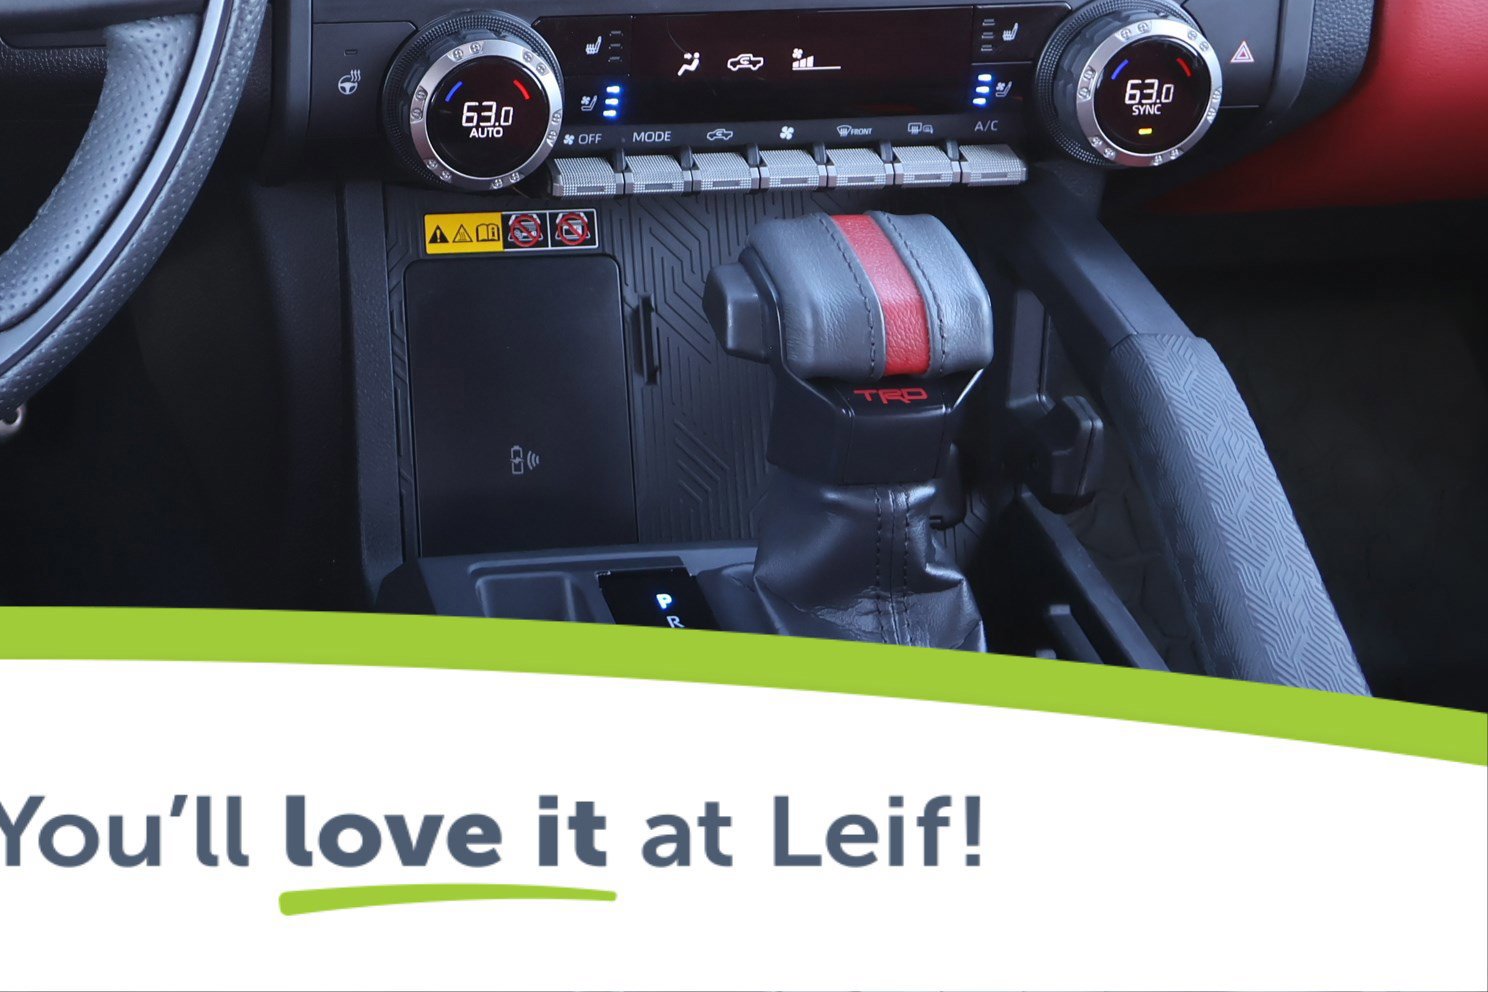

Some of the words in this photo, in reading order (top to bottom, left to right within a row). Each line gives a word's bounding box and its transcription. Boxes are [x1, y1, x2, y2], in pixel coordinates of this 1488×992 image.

[1124, 79, 1175, 105] 63.0
[462, 101, 514, 127] 63.0
[1132, 103, 1161, 115] SYNC
[469, 127, 503, 138] AUTO
[850, 126, 873, 136] FRONT
[974, 120, 998, 133] A/C
[578, 133, 602, 146] OFF
[633, 130, 672, 143] MODE
[853, 387, 929, 404] TRD
[655, 593, 673, 610] P
[666, 615, 685, 628] R
